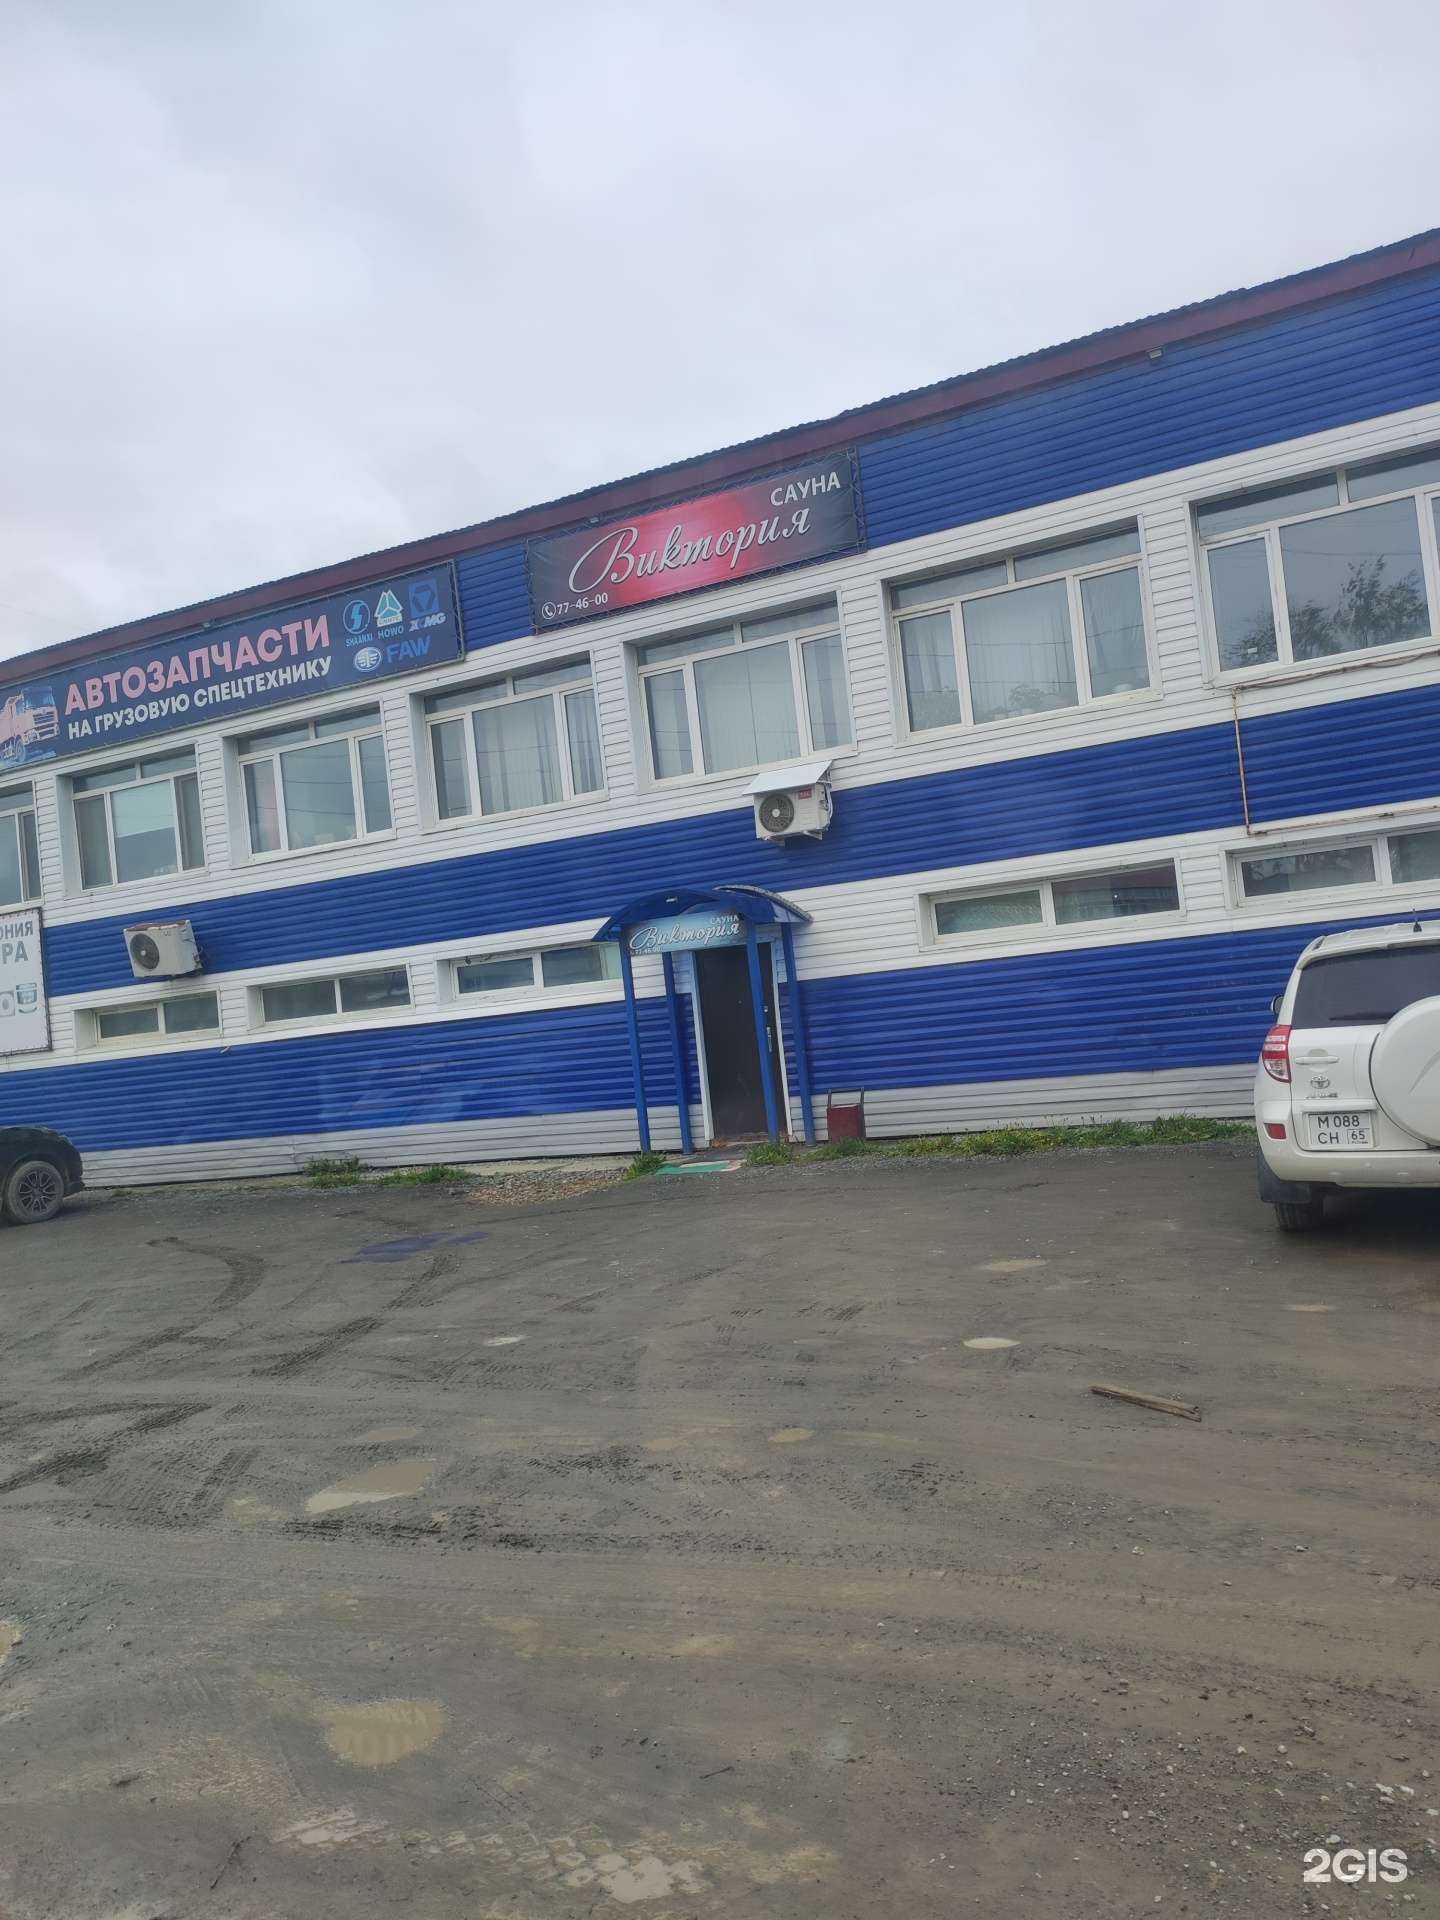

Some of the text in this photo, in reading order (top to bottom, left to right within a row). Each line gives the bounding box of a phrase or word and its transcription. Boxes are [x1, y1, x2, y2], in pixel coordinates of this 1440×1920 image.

[770, 471, 841, 506] САУНА
[568, 506, 812, 594] Виктория
[557, 592, 608, 615] 77-46-00
[378, 625, 404, 638] HOWO
[386, 635, 432, 663] FAW
[64, 615, 330, 715] АВТОЗАПЧАСТИ
[68, 655, 332, 740] НА ГРУЗОВУЮ СПЕЦТЕХНИКУ
[629, 923, 740, 949] Виктория
[1333, 1115, 1360, 1128] 088
[1317, 1132, 1339, 1144] СН
[1351, 1130, 1366, 1140] 65
